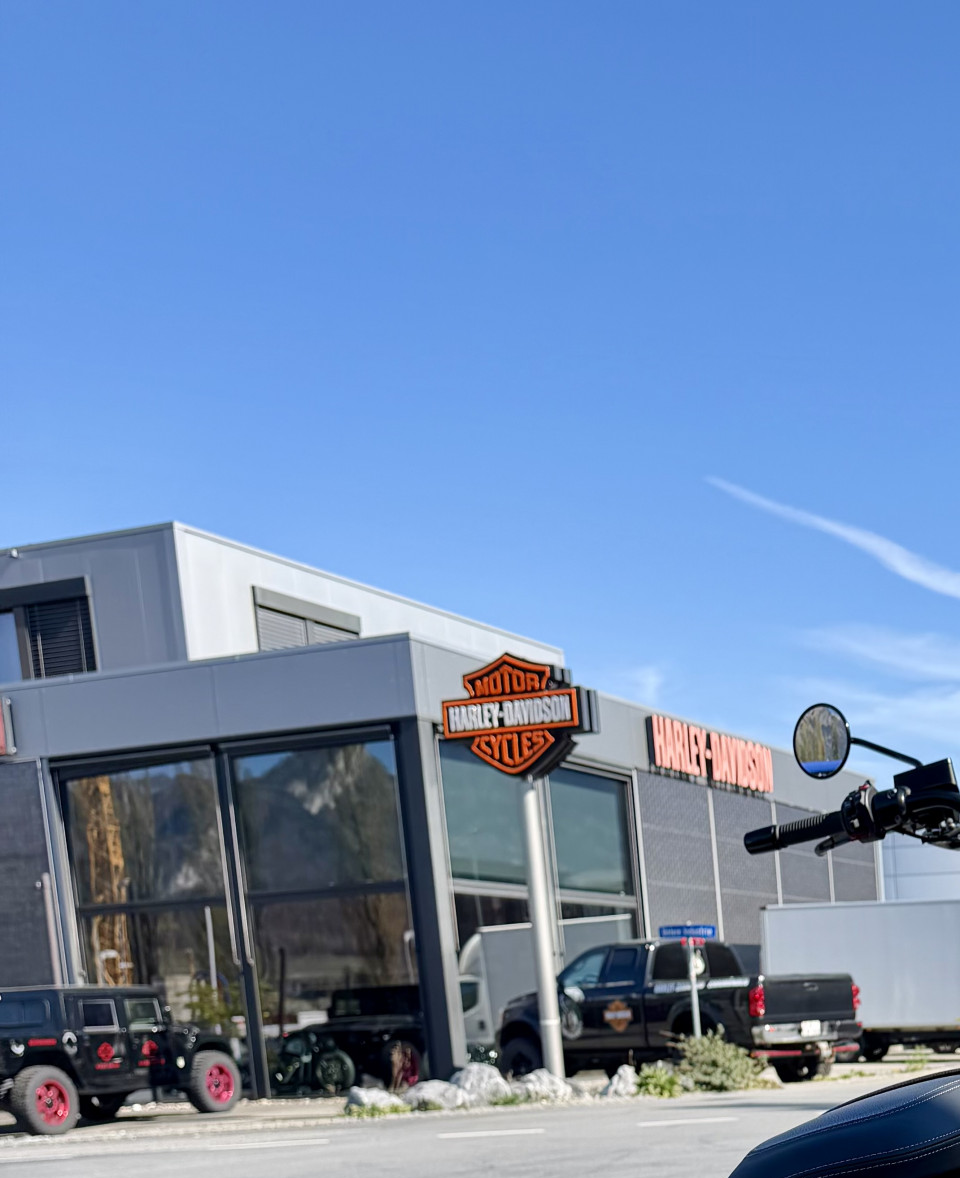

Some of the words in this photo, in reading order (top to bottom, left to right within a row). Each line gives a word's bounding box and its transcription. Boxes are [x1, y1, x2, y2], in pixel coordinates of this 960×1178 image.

[473, 664, 541, 697] MOTOR
[448, 694, 572, 733] HARLEY-DAVIDSON
[478, 730, 546, 767] CYCLES
[651, 713, 774, 793] HARLEY-DAVIDSON
